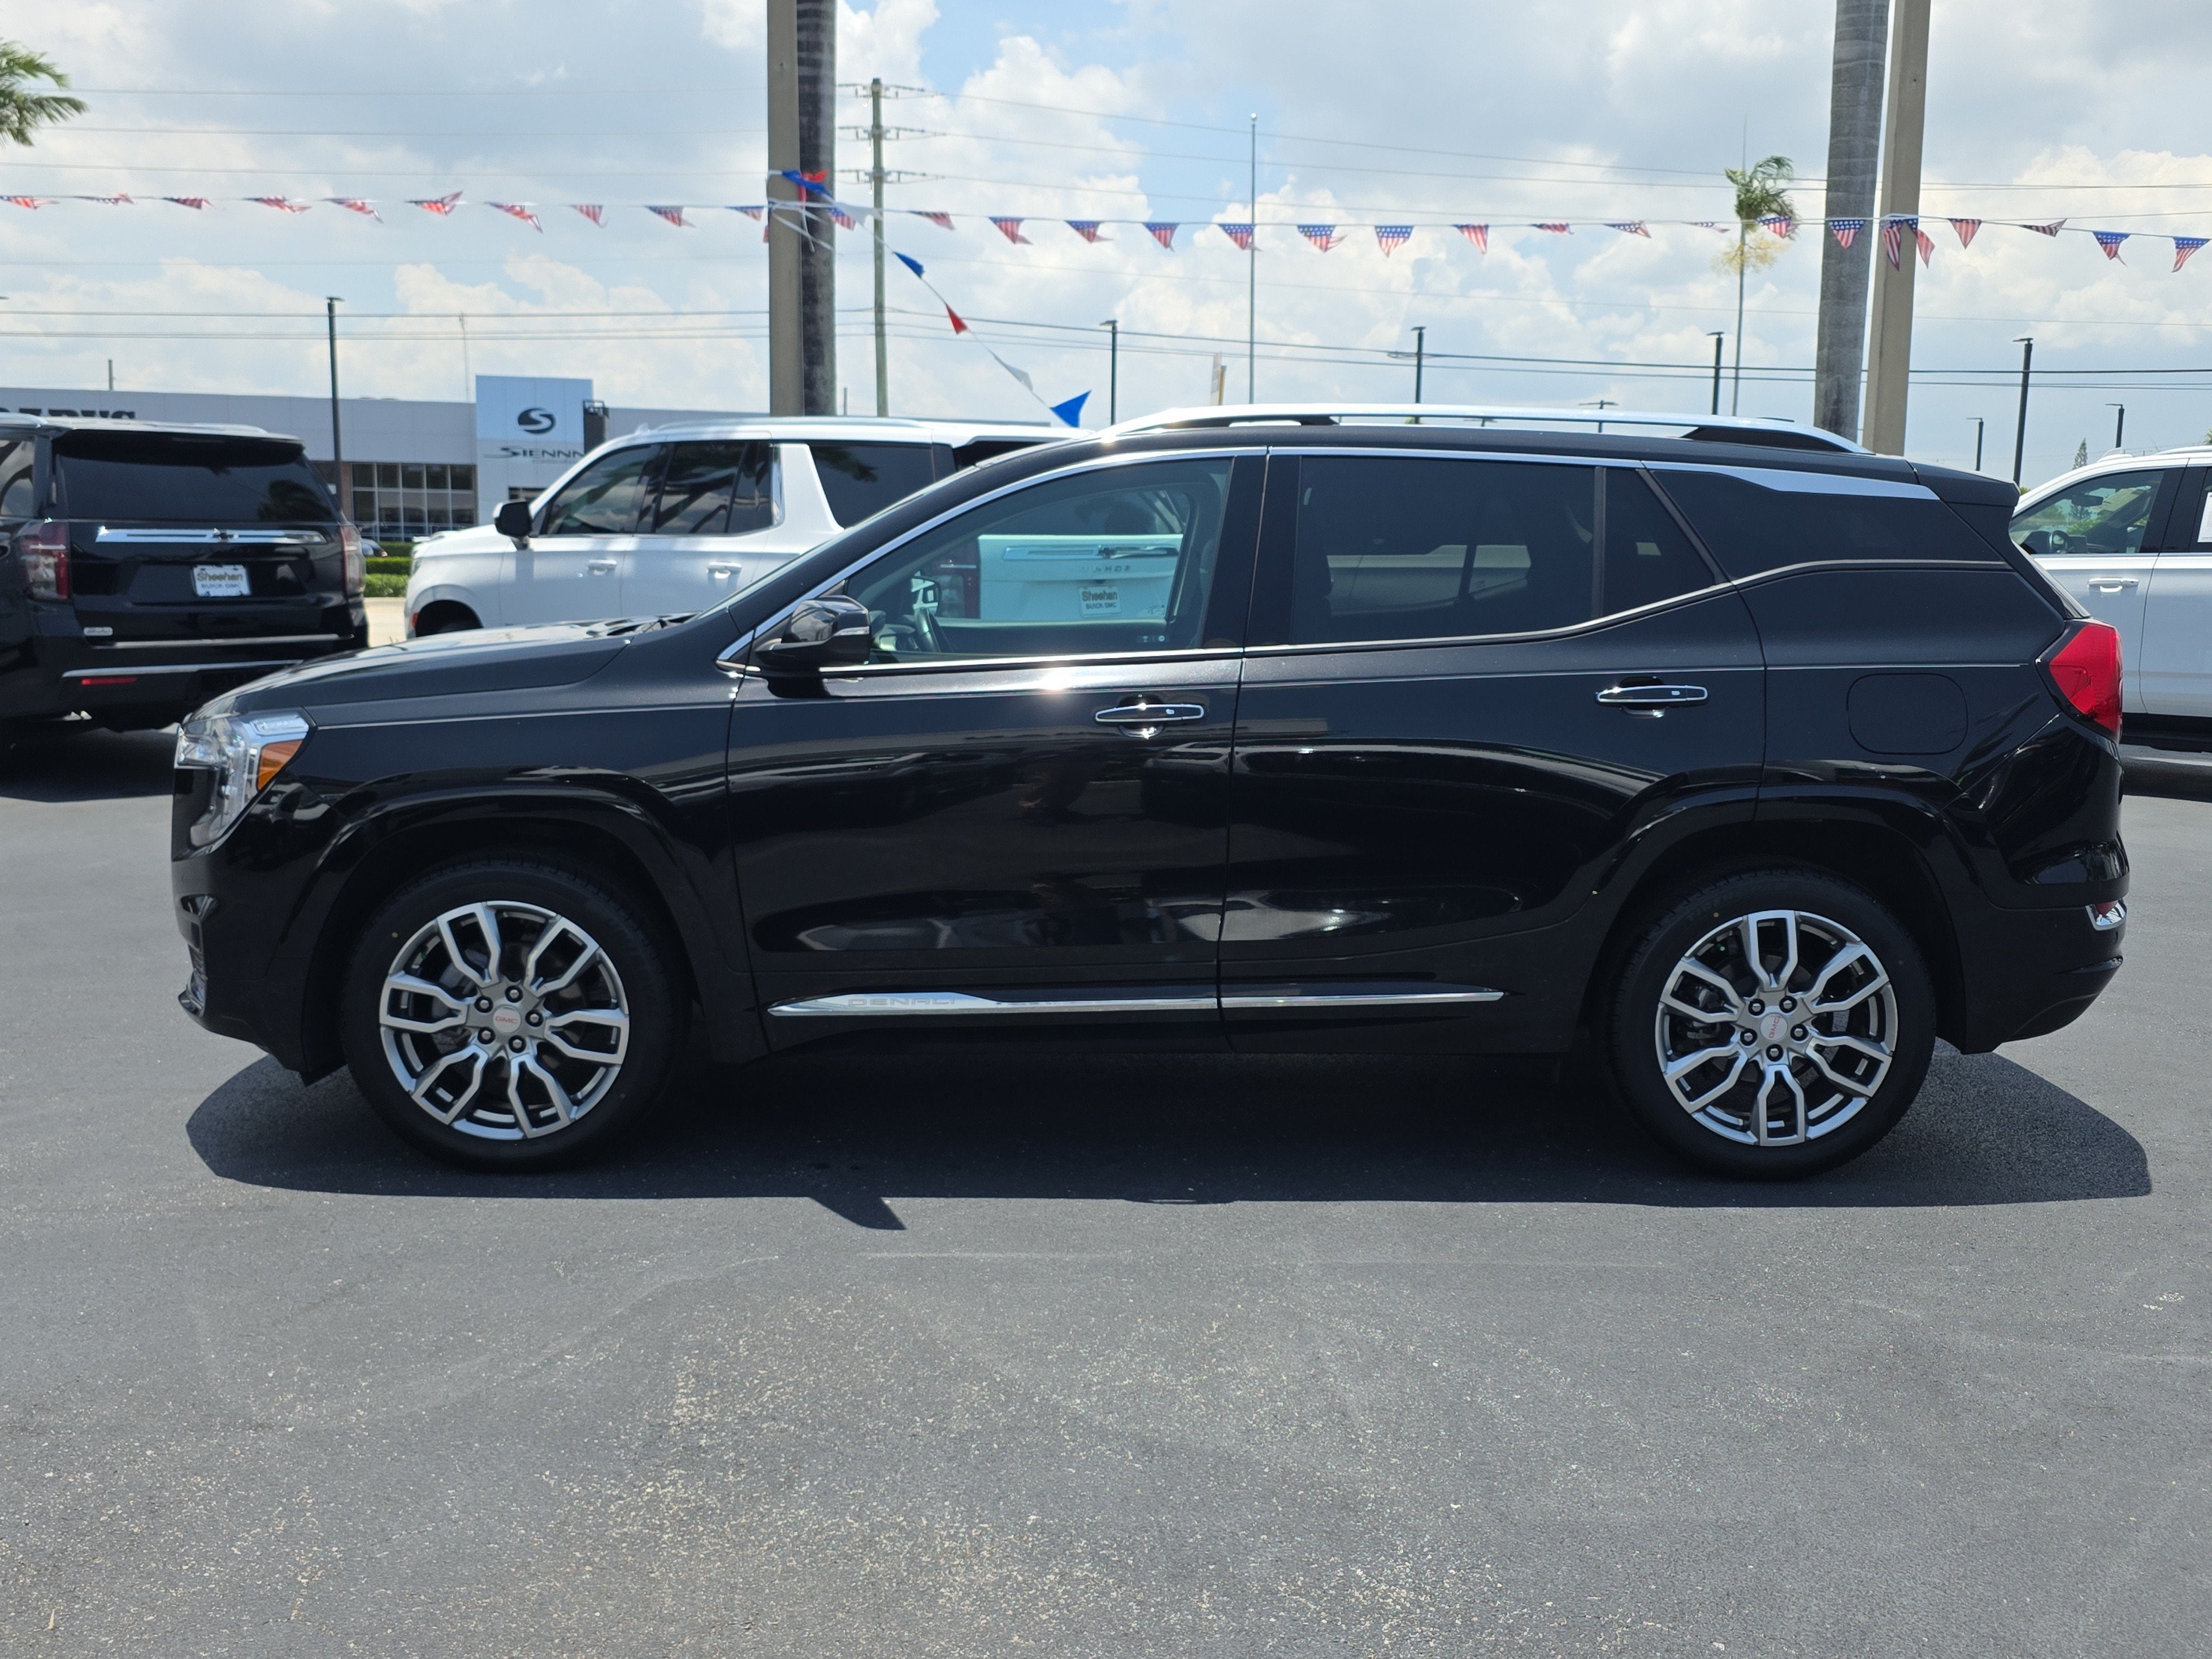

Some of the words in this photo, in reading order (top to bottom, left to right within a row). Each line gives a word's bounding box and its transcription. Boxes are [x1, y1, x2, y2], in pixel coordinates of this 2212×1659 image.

[848, 997, 955, 1007] DENALI
[496, 1015, 519, 1024] GMC
[1769, 1016, 1780, 1038] GMC
